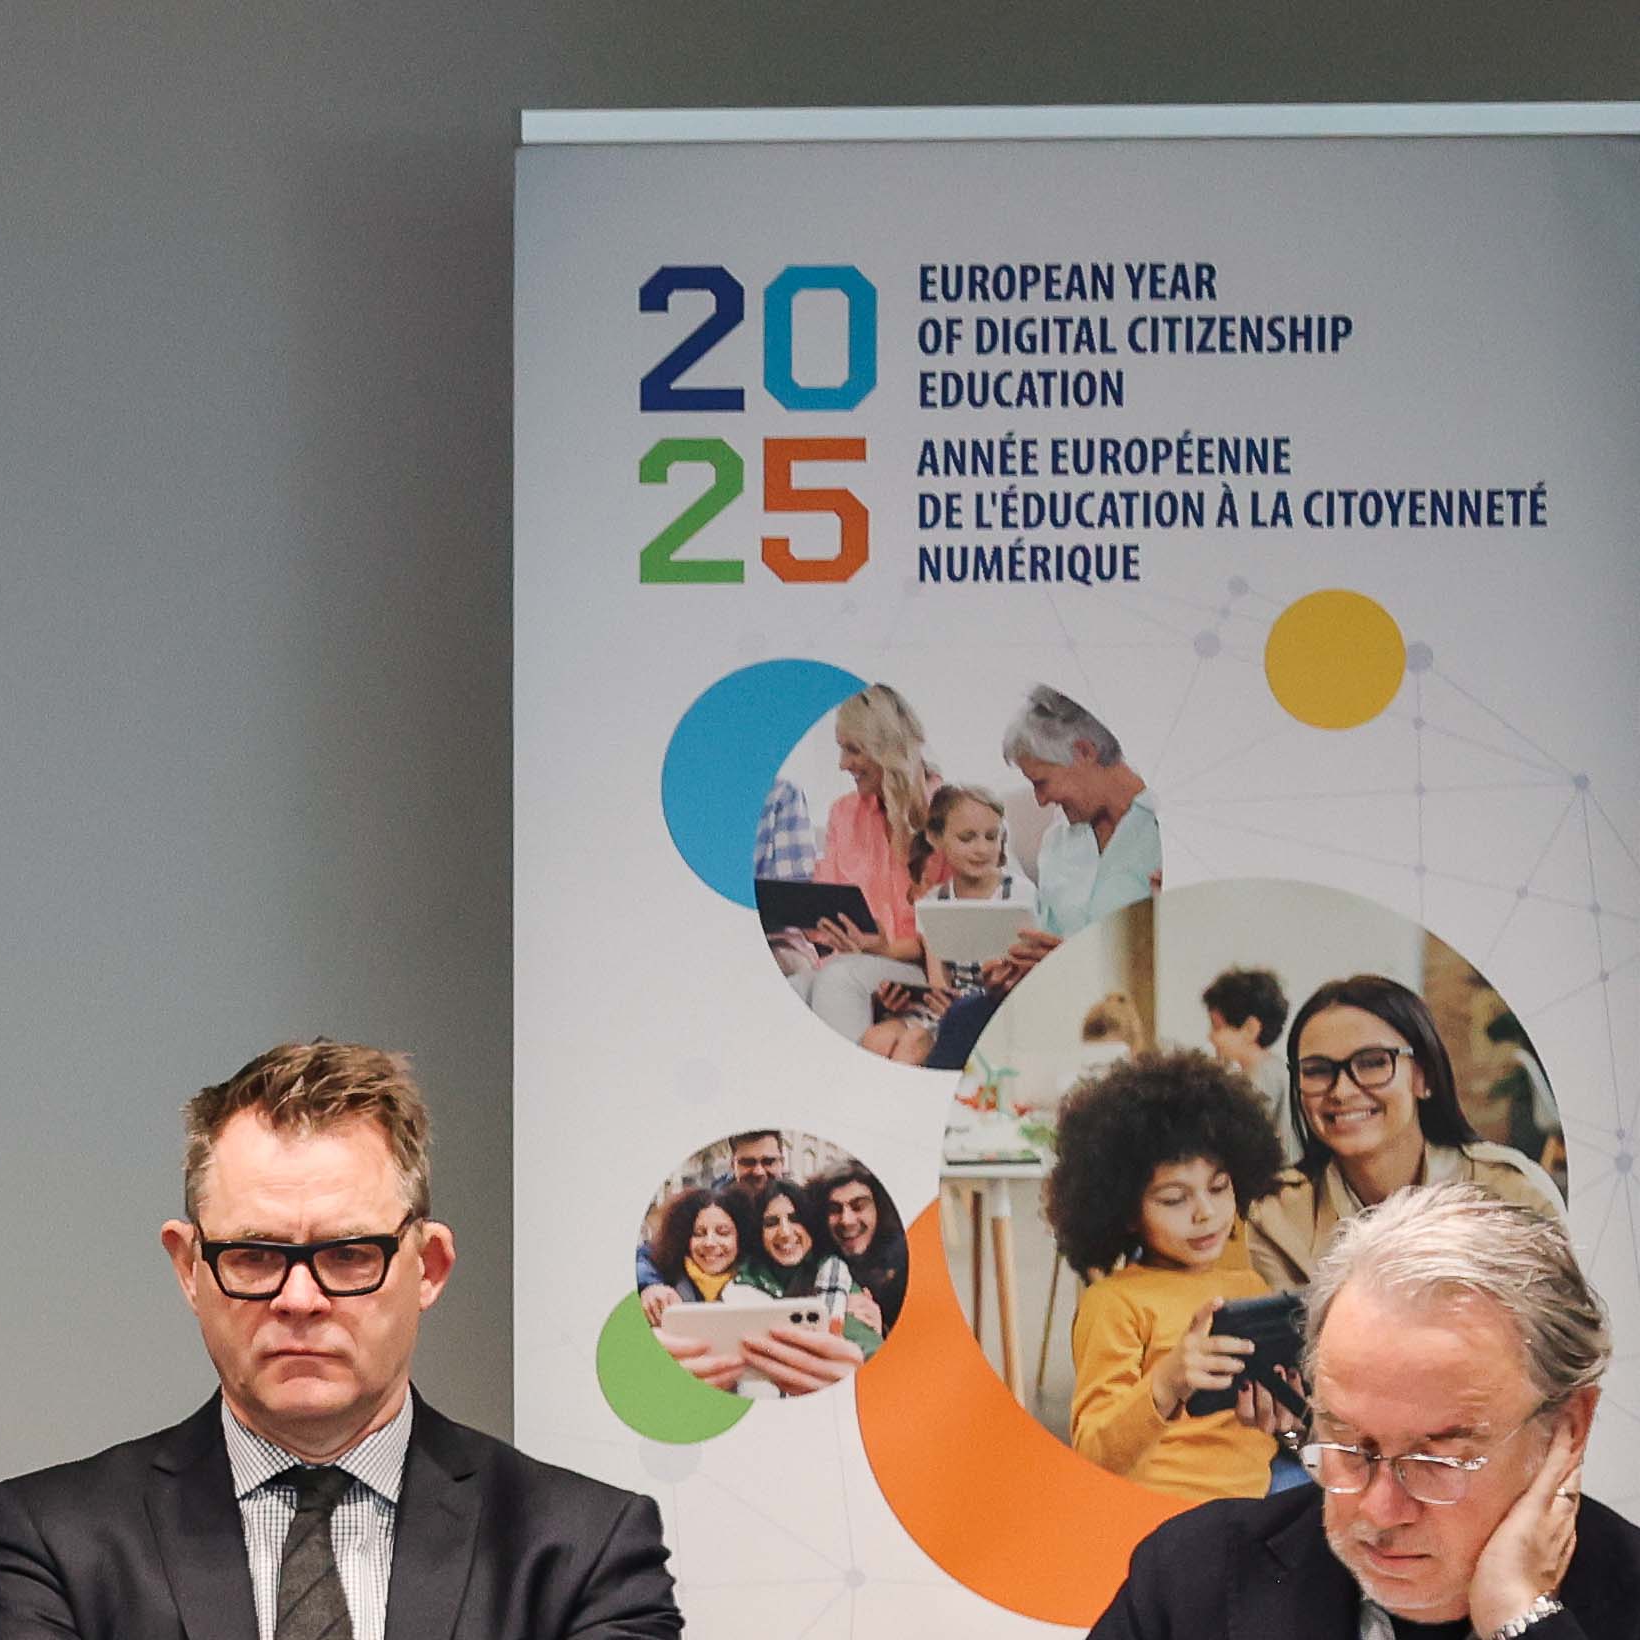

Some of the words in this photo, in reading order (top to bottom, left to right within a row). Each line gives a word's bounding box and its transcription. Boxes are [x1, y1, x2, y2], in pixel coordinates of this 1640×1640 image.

[919, 262, 1115, 303] EUROPEAN
[1124, 262, 1217, 301] YEAR
[638, 265, 877, 413] 20
[918, 317, 963, 356] OF
[975, 316, 1118, 355] DIGITAL
[1127, 314, 1353, 354] CITIZENSHIP
[919, 369, 1124, 409] EDUCATION
[916, 429, 1039, 477] ANNÉE
[1051, 429, 1291, 476] EUROPÉENNE
[638, 436, 870, 584] 25
[918, 492, 963, 530] DE
[975, 484, 1205, 530] L'ÉDUCATION
[1215, 482, 1239, 528] À
[1251, 490, 1293, 529] LA
[1303, 481, 1548, 528] CITOYENNETÉ
[918, 537, 1141, 587] NUMÉRIQUE
